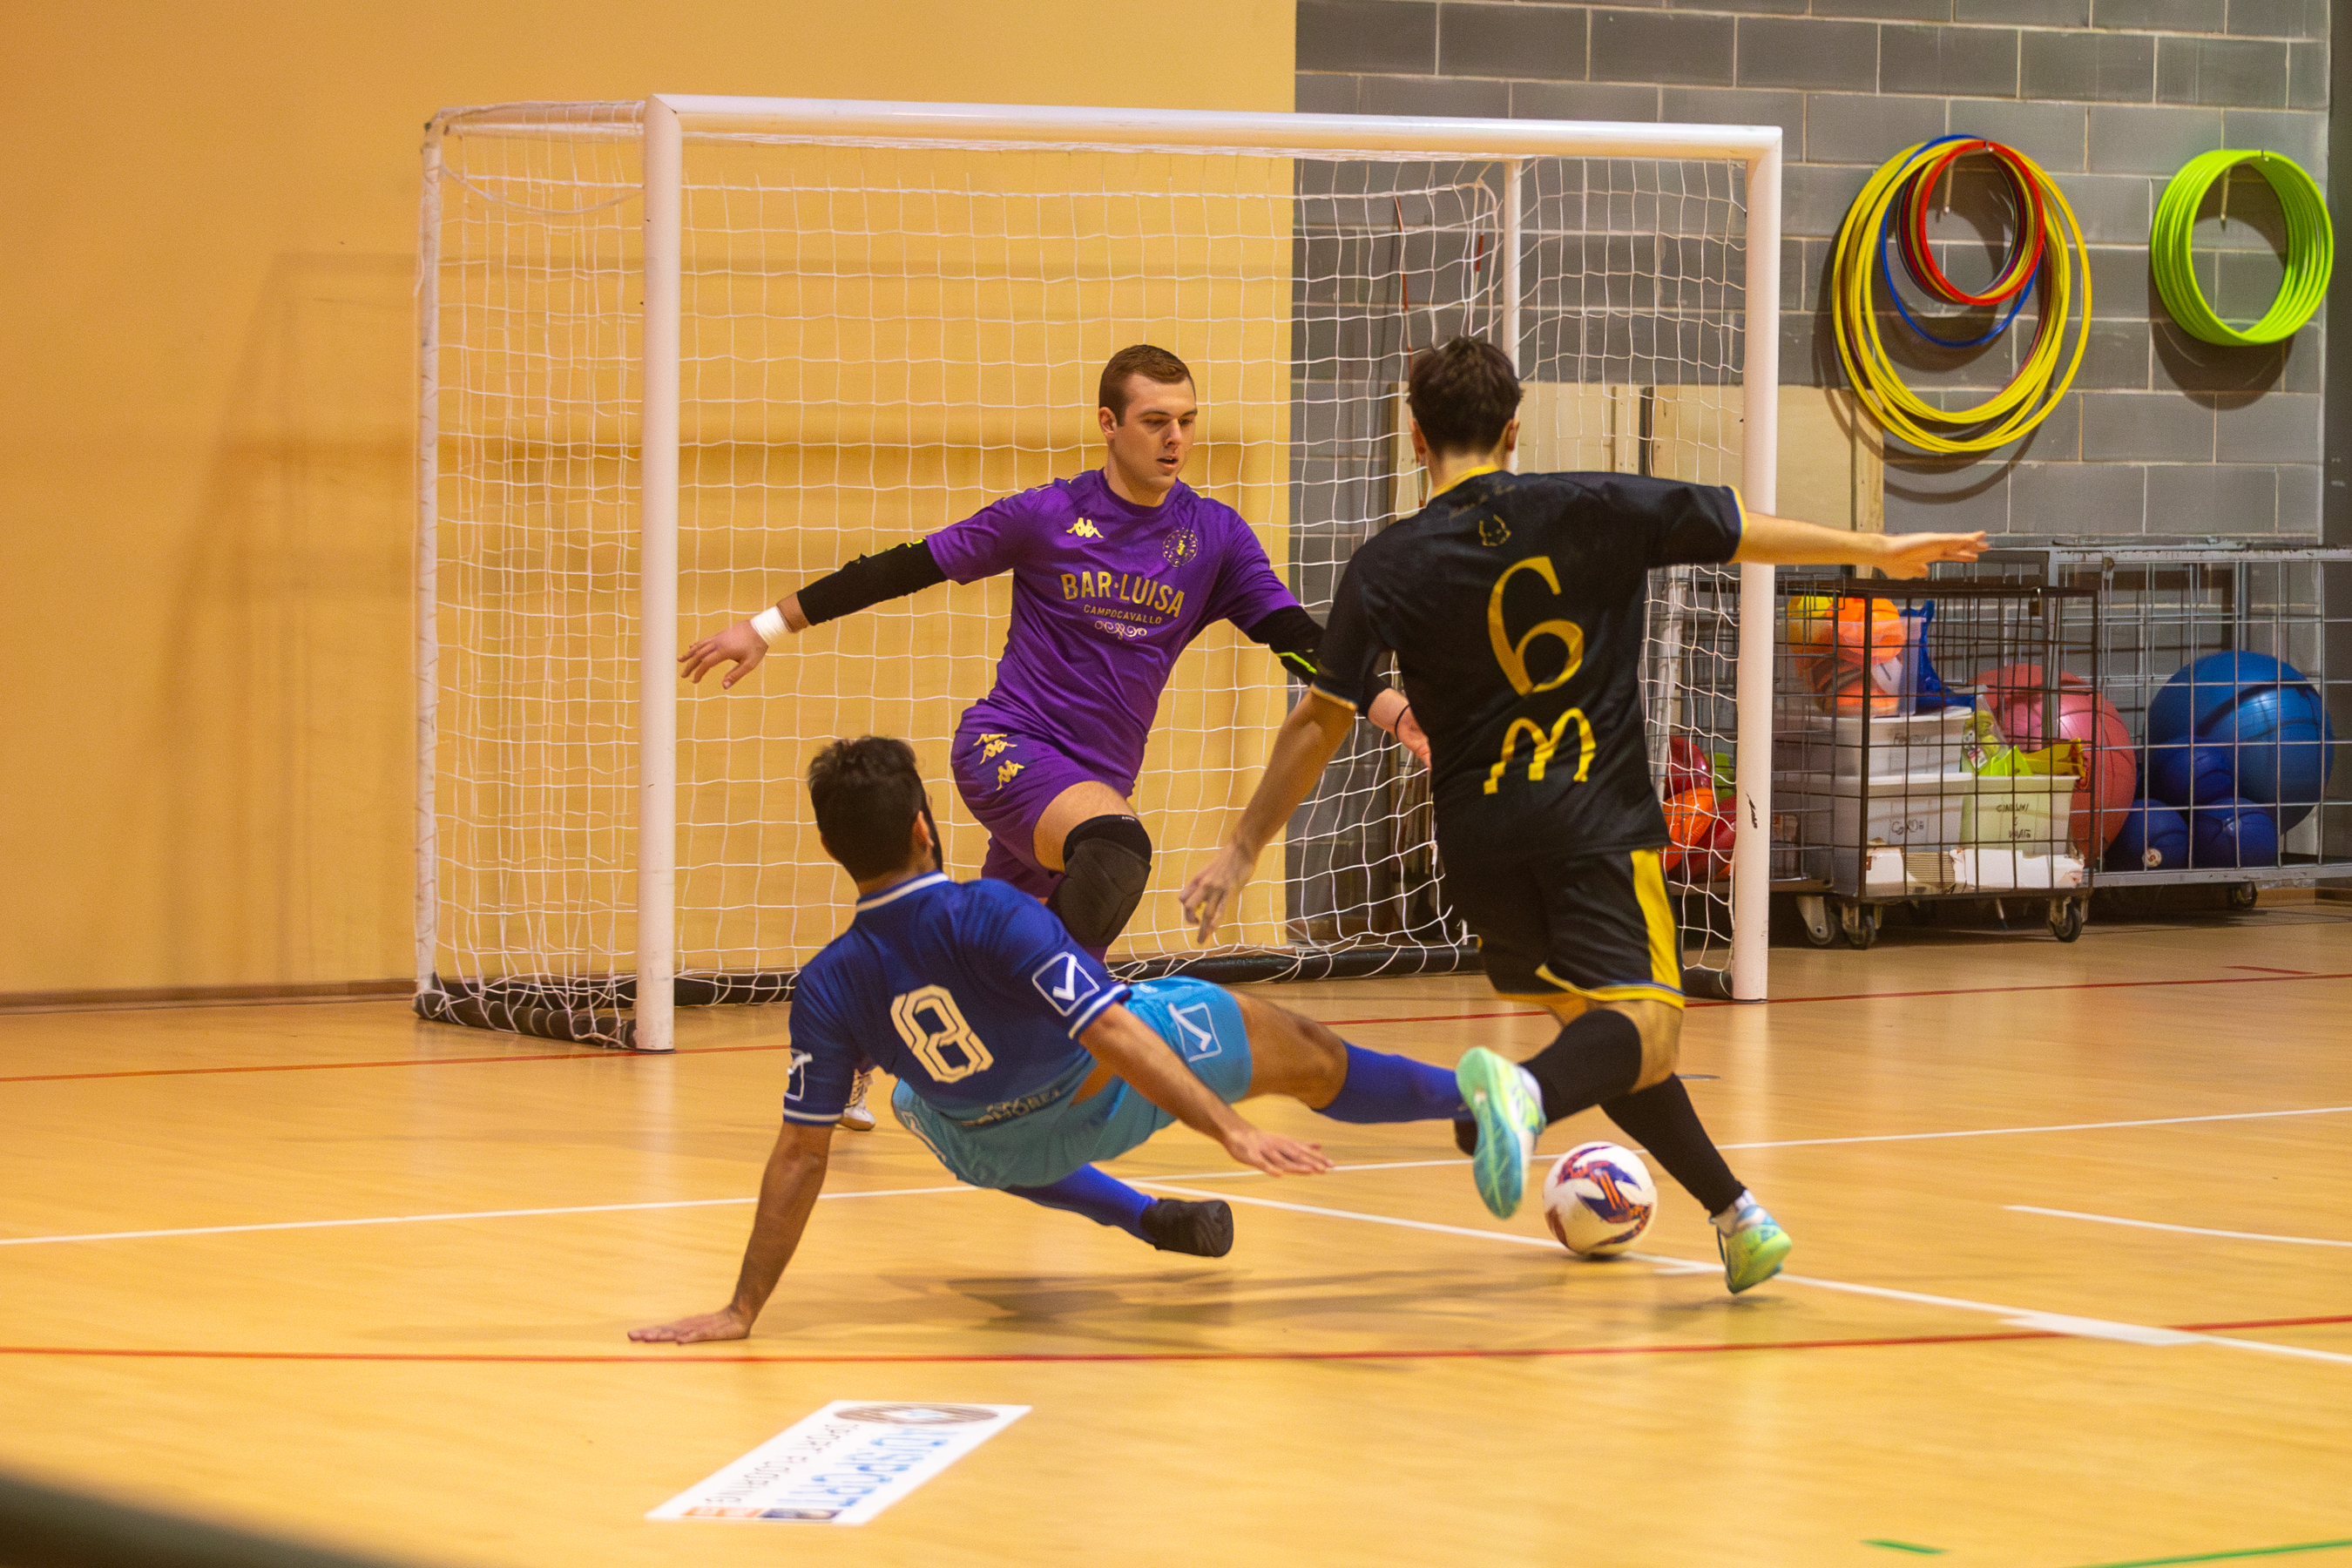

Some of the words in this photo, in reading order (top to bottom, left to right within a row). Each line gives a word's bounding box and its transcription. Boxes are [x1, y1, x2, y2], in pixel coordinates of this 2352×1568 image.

[1084, 604, 1162, 625] CAMPOCAVALLO
[1488, 555, 1584, 696] 6
[890, 984, 994, 1083] 8
